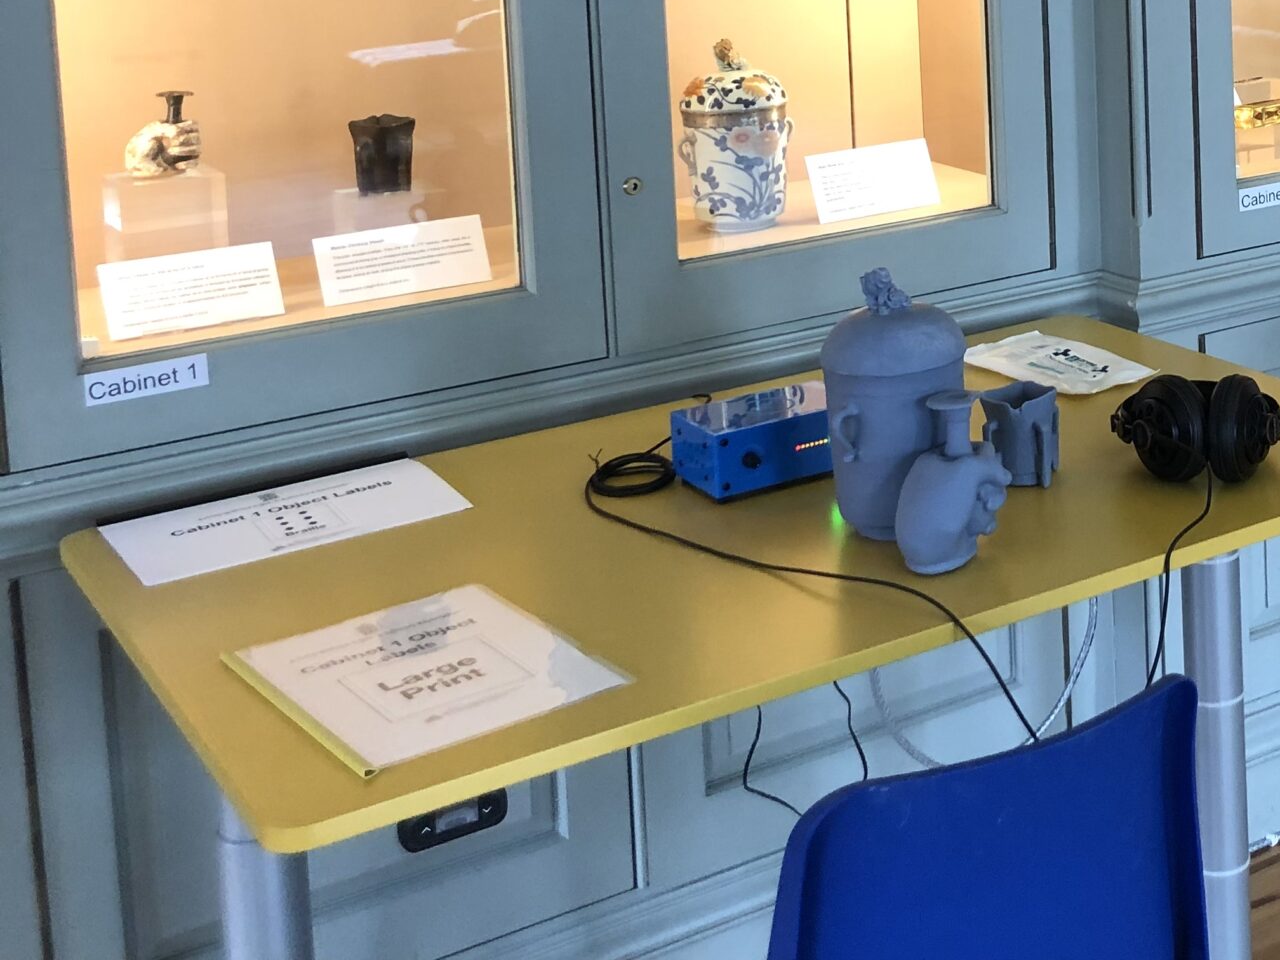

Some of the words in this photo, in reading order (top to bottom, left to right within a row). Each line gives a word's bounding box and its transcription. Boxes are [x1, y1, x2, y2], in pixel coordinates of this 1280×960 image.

[88, 368, 180, 401] Cabinet
[188, 362, 198, 381] 1
[170, 515, 246, 538] Cabinet
[251, 510, 262, 519] 1
[267, 494, 329, 515] Object
[333, 479, 393, 499] Labels
[300, 645, 386, 676] Cabinet
[407, 617, 478, 643] Object
[364, 640, 437, 667] Labels
[377, 655, 478, 693] Large
[400, 667, 487, 701] Print
